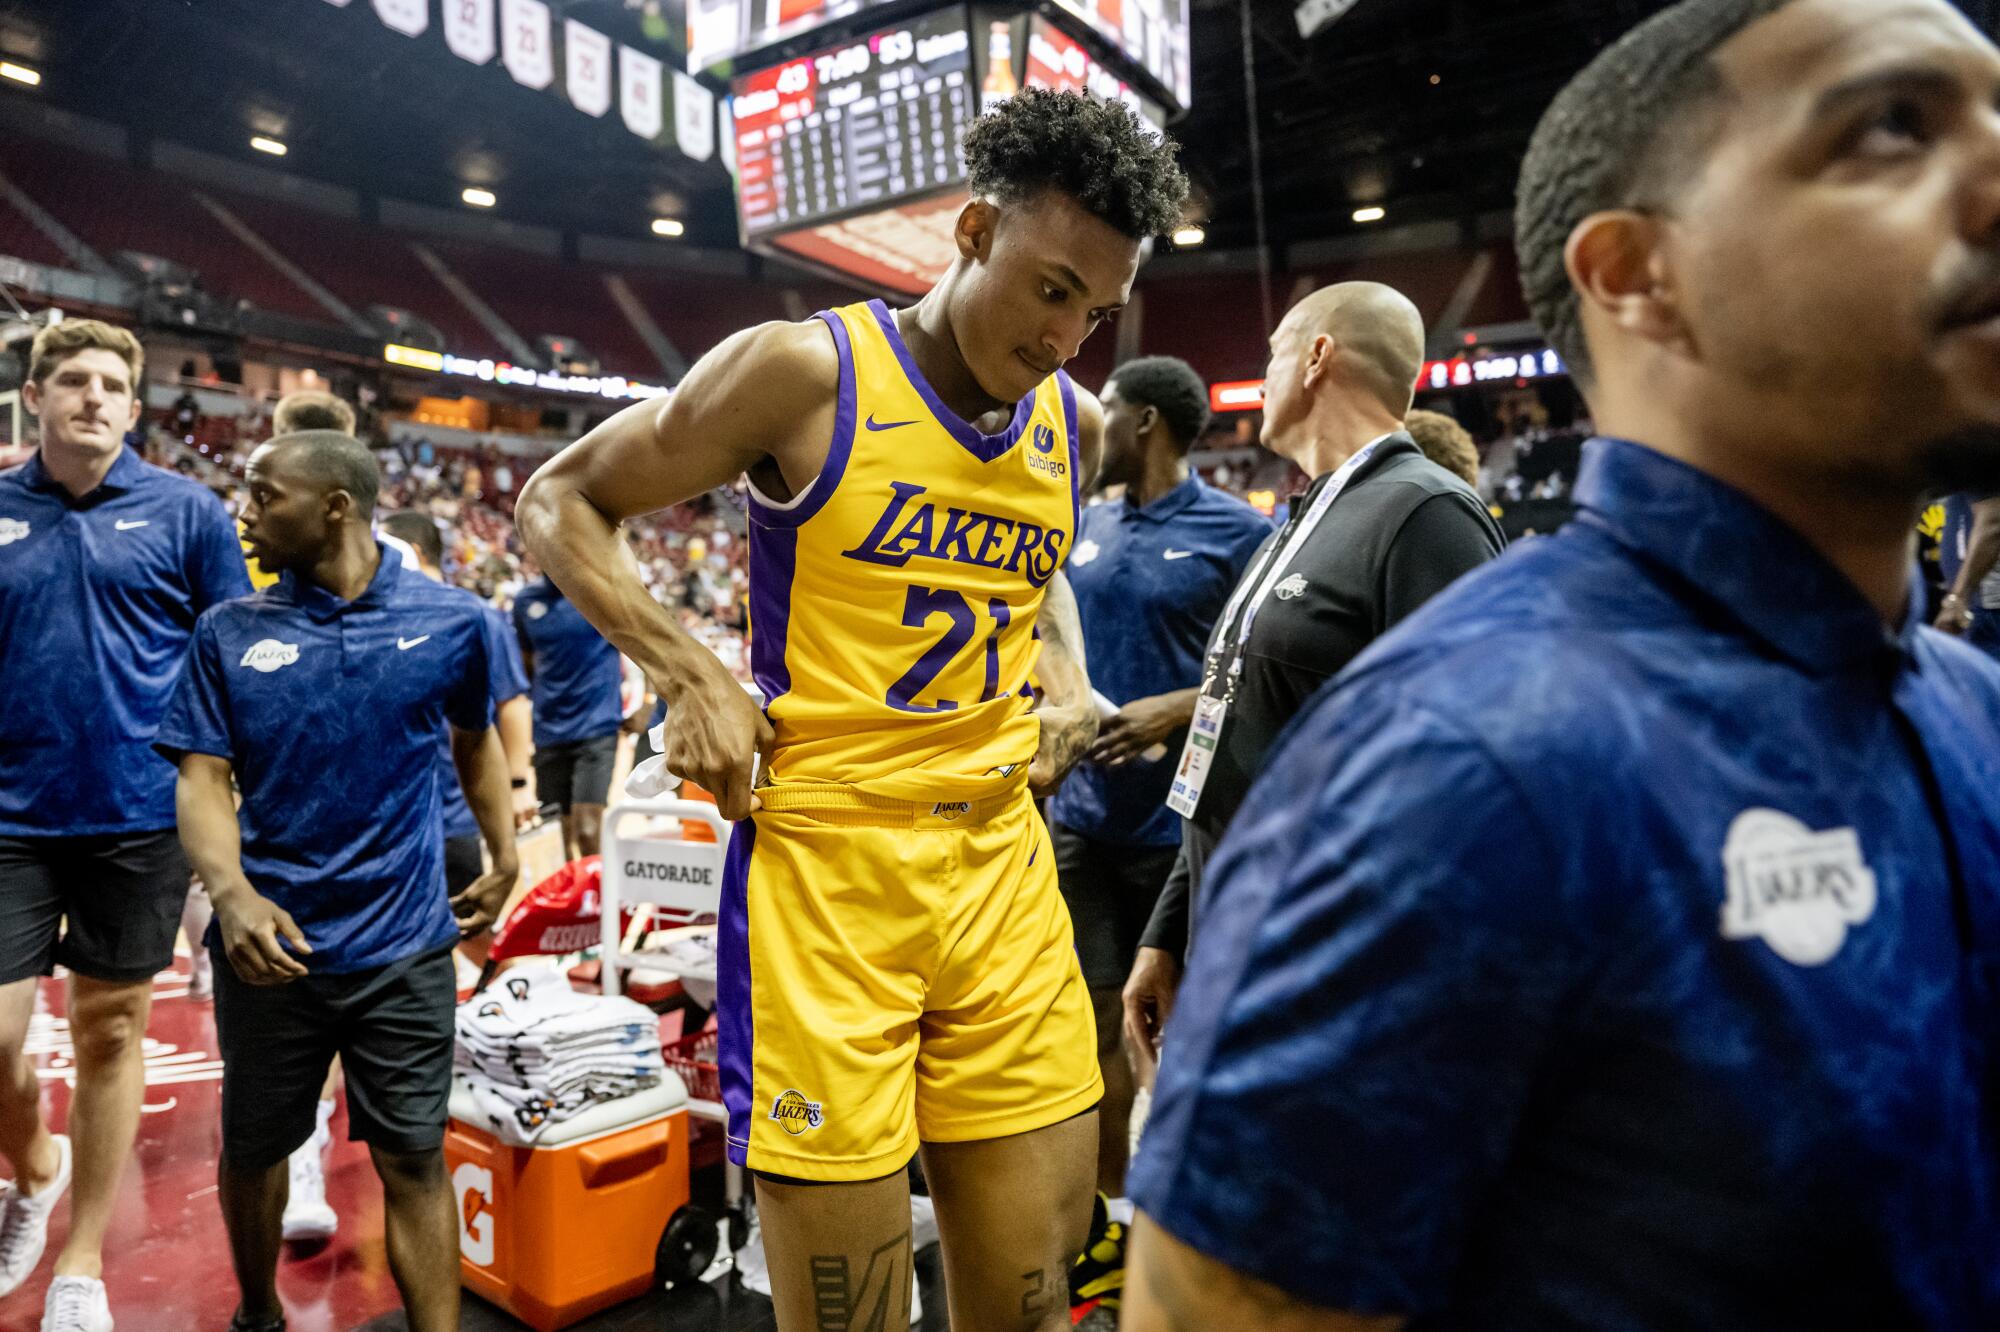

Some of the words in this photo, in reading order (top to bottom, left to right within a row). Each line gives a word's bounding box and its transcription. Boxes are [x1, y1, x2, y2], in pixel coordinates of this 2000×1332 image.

[1027, 452, 1066, 479] bibigo
[840, 480, 1065, 589] LAKERS
[885, 584, 1011, 713] 21
[624, 860, 713, 886] GATORADE
[770, 1098, 823, 1127] LAKERS
[452, 1162, 494, 1266] G
